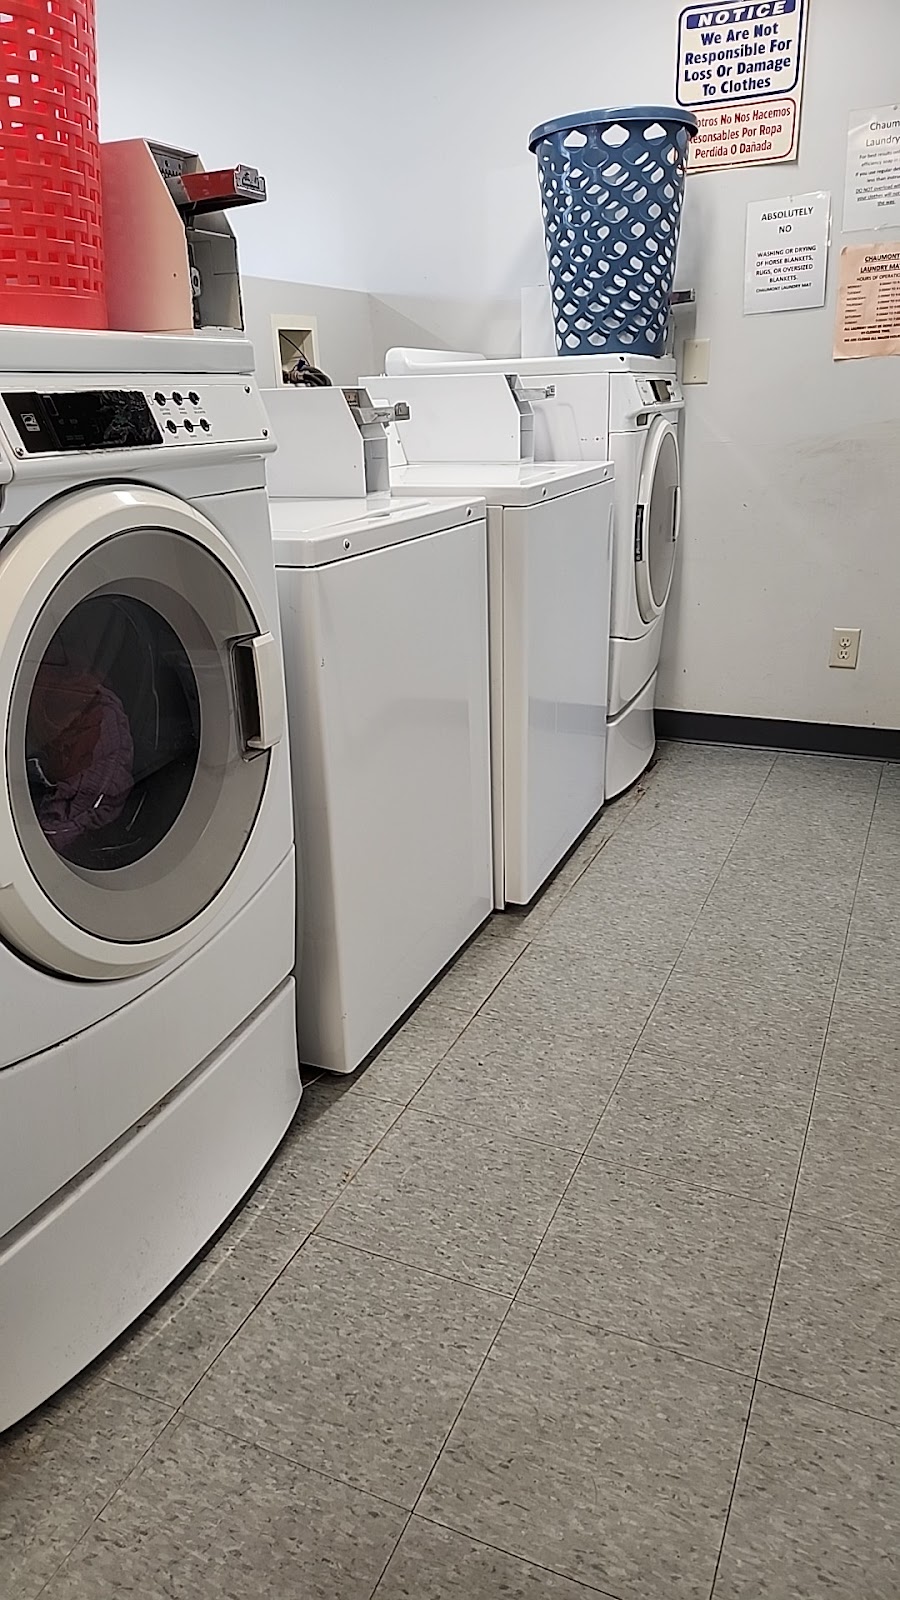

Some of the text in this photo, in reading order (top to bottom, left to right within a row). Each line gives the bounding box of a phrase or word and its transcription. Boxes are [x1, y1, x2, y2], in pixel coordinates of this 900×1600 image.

[698, 0, 786, 28] NOTICE
[701, 22, 779, 46] We Are Not
[685, 39, 793, 66] Responsible For
[684, 57, 791, 82] Loss Or Damage
[702, 77, 771, 96] To Clothes
[720, 113, 732, 125] No
[734, 111, 751, 124] Nos
[752, 107, 791, 120] Hacemos
[741, 127, 758, 138] Por
[759, 123, 782, 136] Ropa
[695, 139, 772, 159] Perdida O Dañada
[761, 206, 814, 222] ABSOLUTELY
[778, 224, 792, 234] NO
[757, 249, 784, 258] WASHING
[795, 245, 816, 253] DRYING
[864, 253, 900, 264] CHAUMONT
[765, 258, 782, 266] HORSE
[773, 266, 782, 274] OR
[783, 263, 814, 273] OVERSIZED
[860, 264, 888, 274] LAUNDRY
